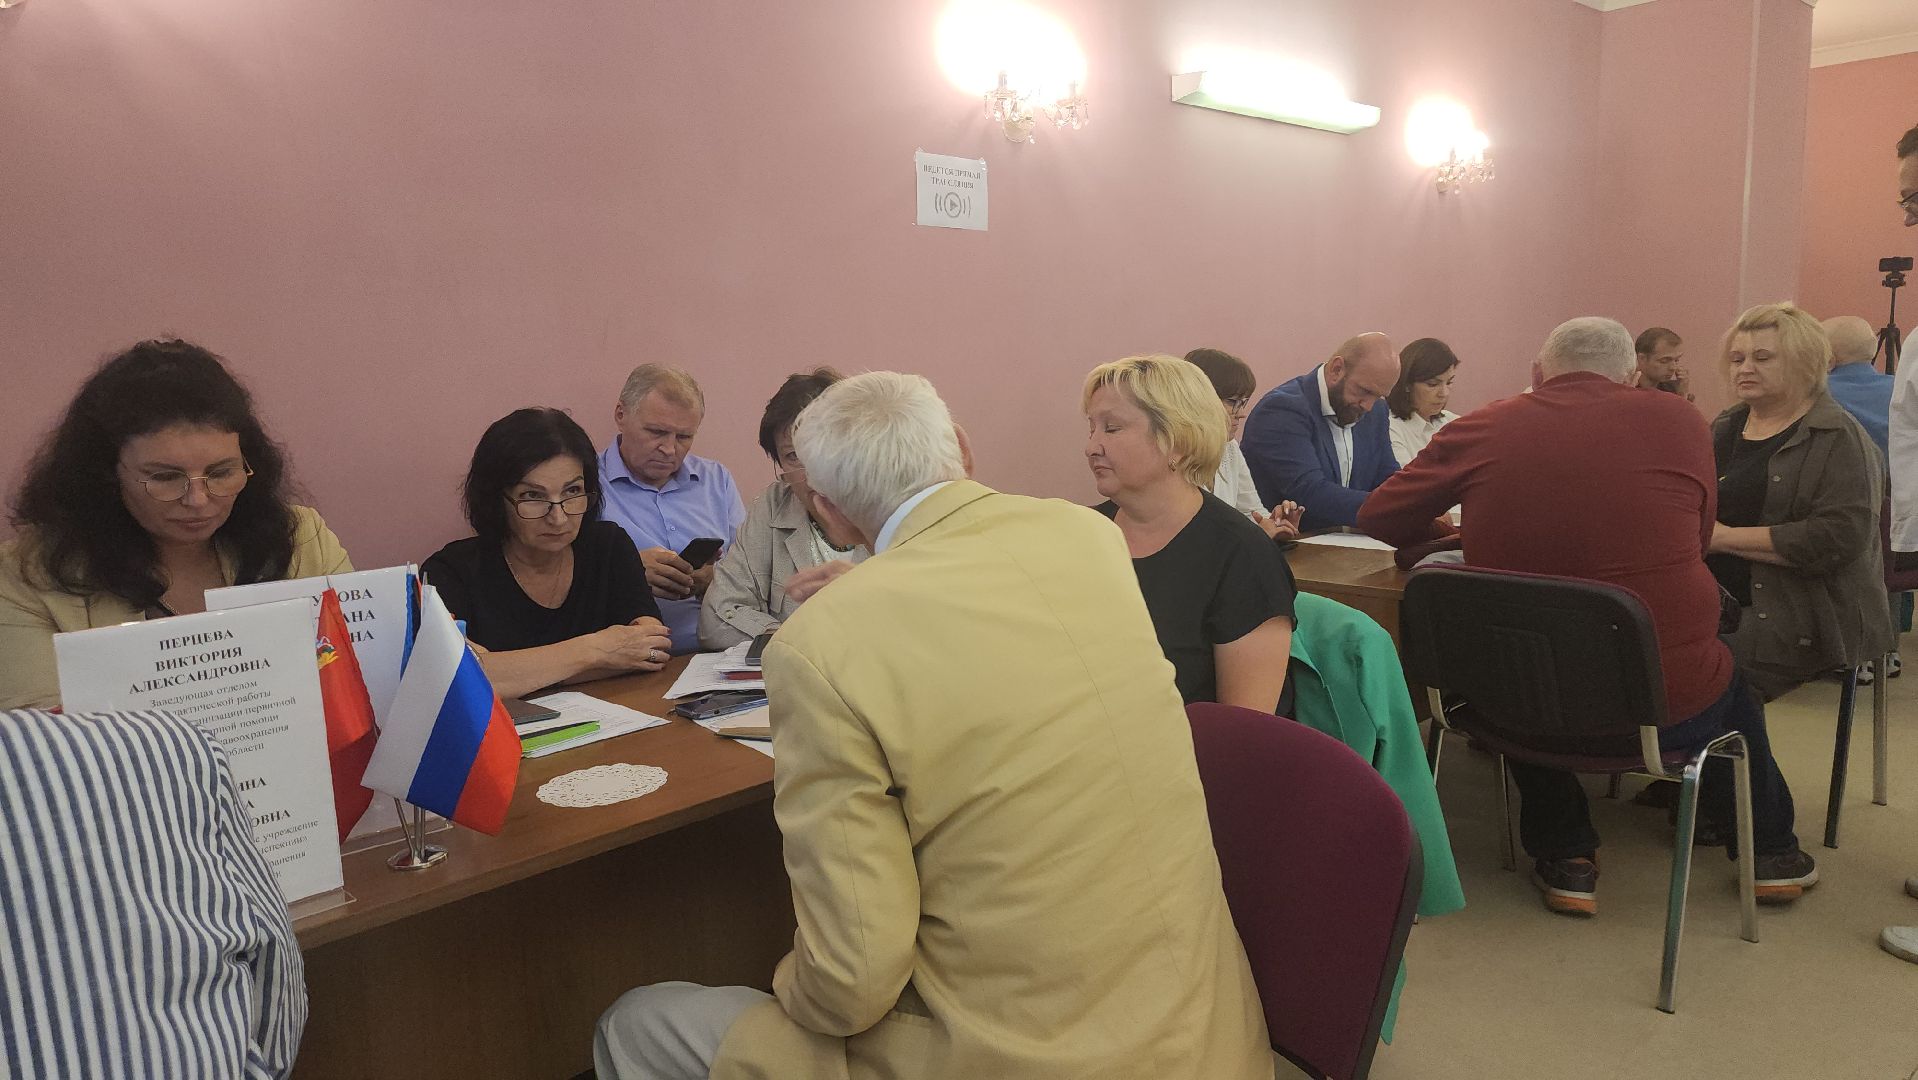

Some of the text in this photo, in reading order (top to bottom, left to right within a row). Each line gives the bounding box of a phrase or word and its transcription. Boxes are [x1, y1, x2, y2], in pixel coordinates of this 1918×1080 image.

[159, 629, 234, 651] ПЕРЦЕВА
[155, 646, 243, 673] ВИКТОРИЯ
[129, 657, 271, 695] АЛЕКСАНДРОВНА
[151, 681, 258, 709] Заведующая отделом
[237, 690, 271, 706] работы
[240, 714, 279, 729] помощи
